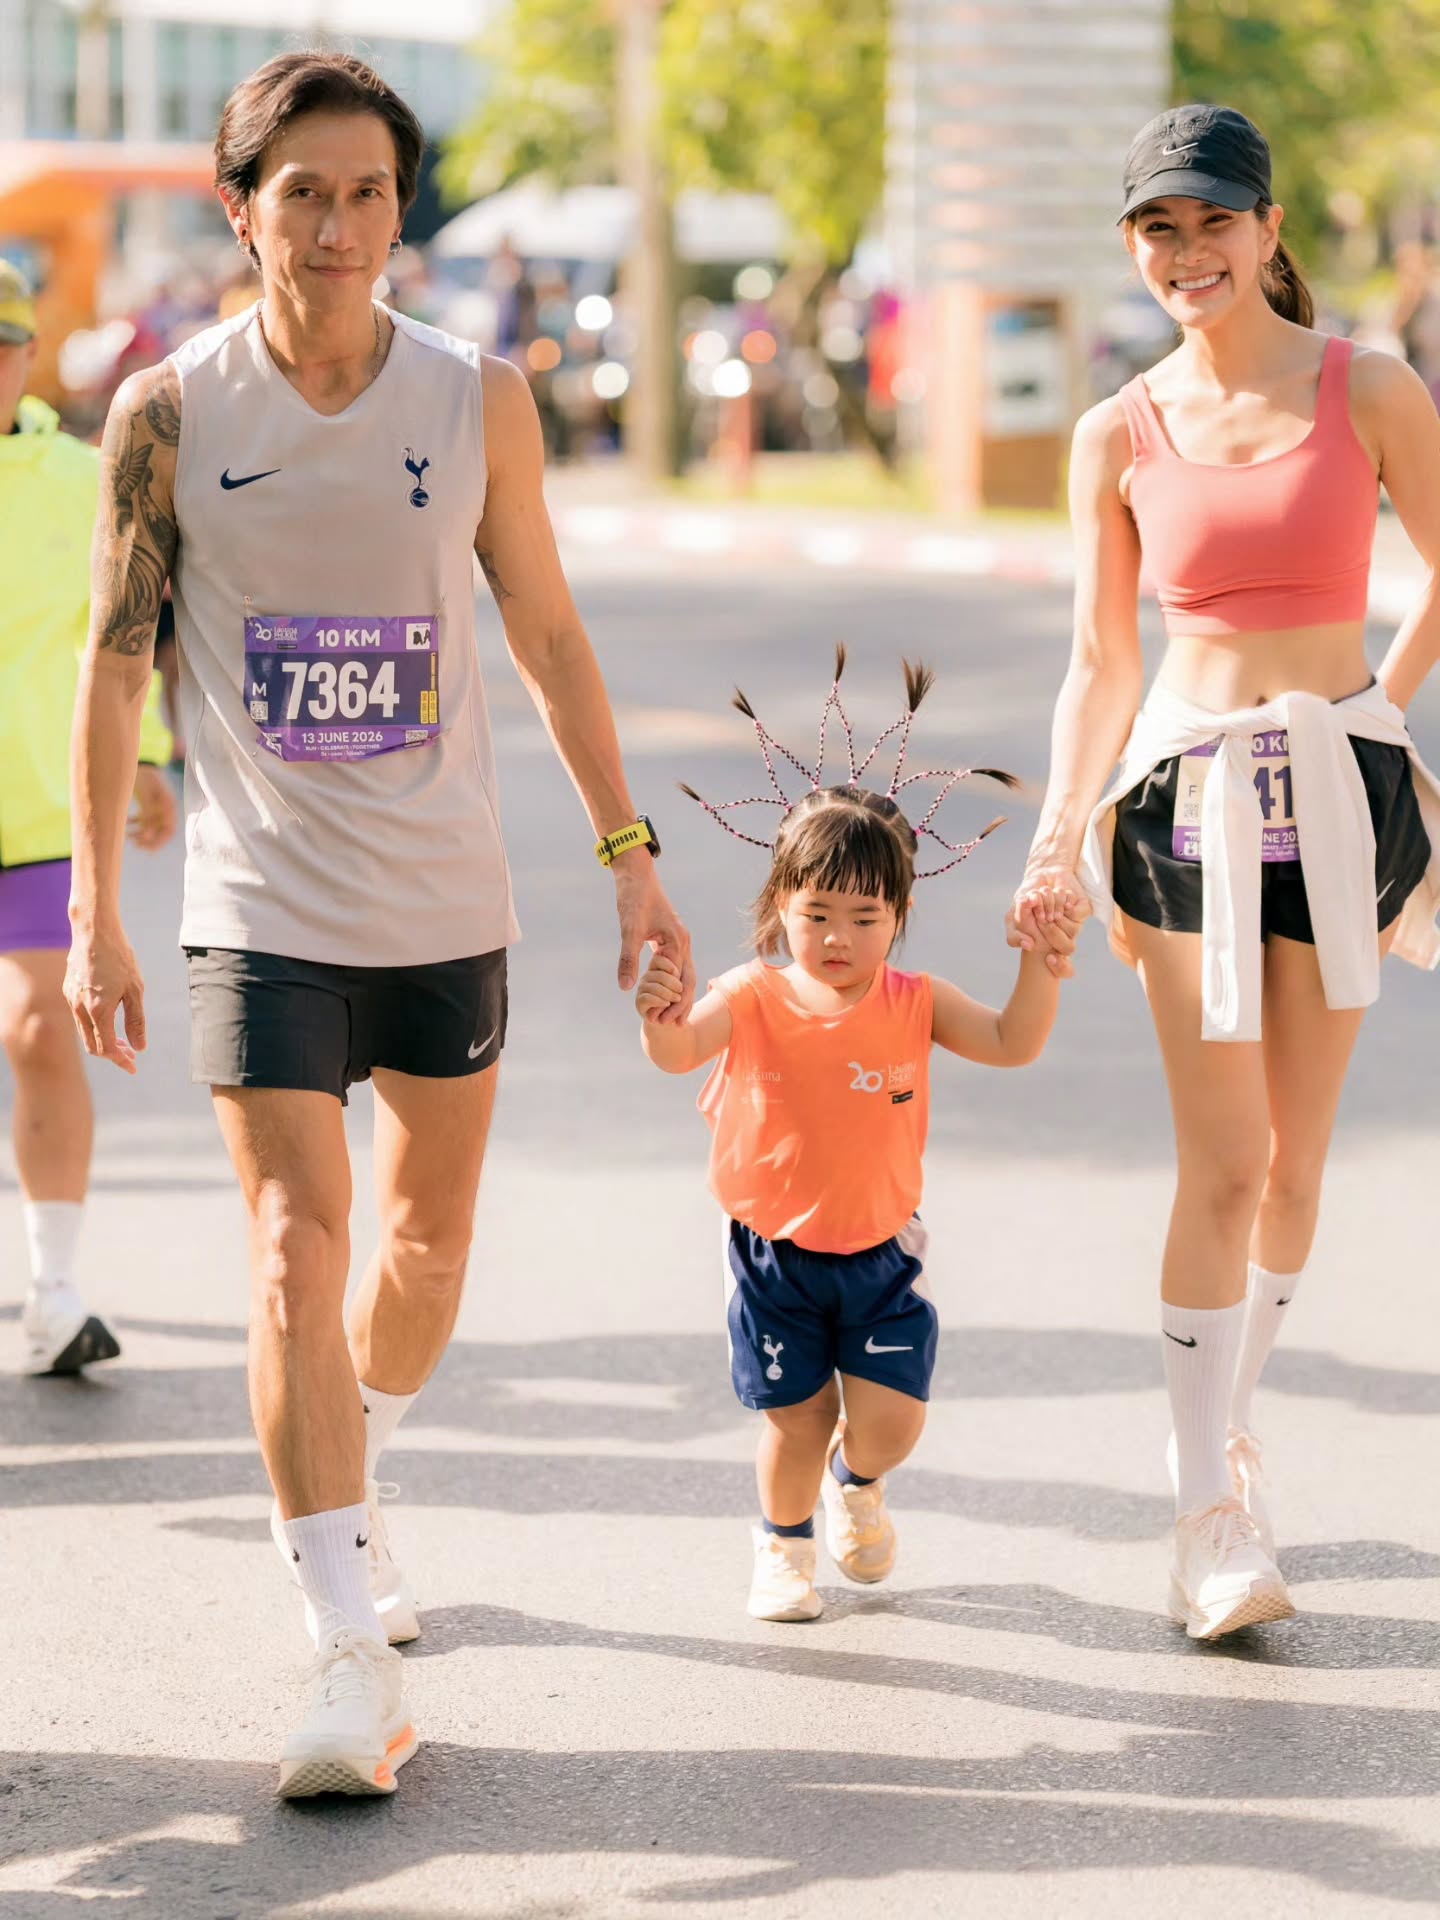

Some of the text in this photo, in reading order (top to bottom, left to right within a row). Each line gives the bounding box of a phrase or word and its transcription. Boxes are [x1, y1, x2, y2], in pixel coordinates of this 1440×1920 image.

[254, 623, 272, 641] 20
[316, 629, 381, 648] 10 KM
[252, 682, 267, 697] M
[282, 661, 400, 720] 7364
[302, 731, 384, 743] 13 JUNE 2026
[1253, 737, 1265, 753] 0
[1188, 785, 1197, 797] F
[1253, 765, 1294, 821] 41
[1263, 831, 1297, 844] NE 20
[848, 1061, 883, 1093] 20
